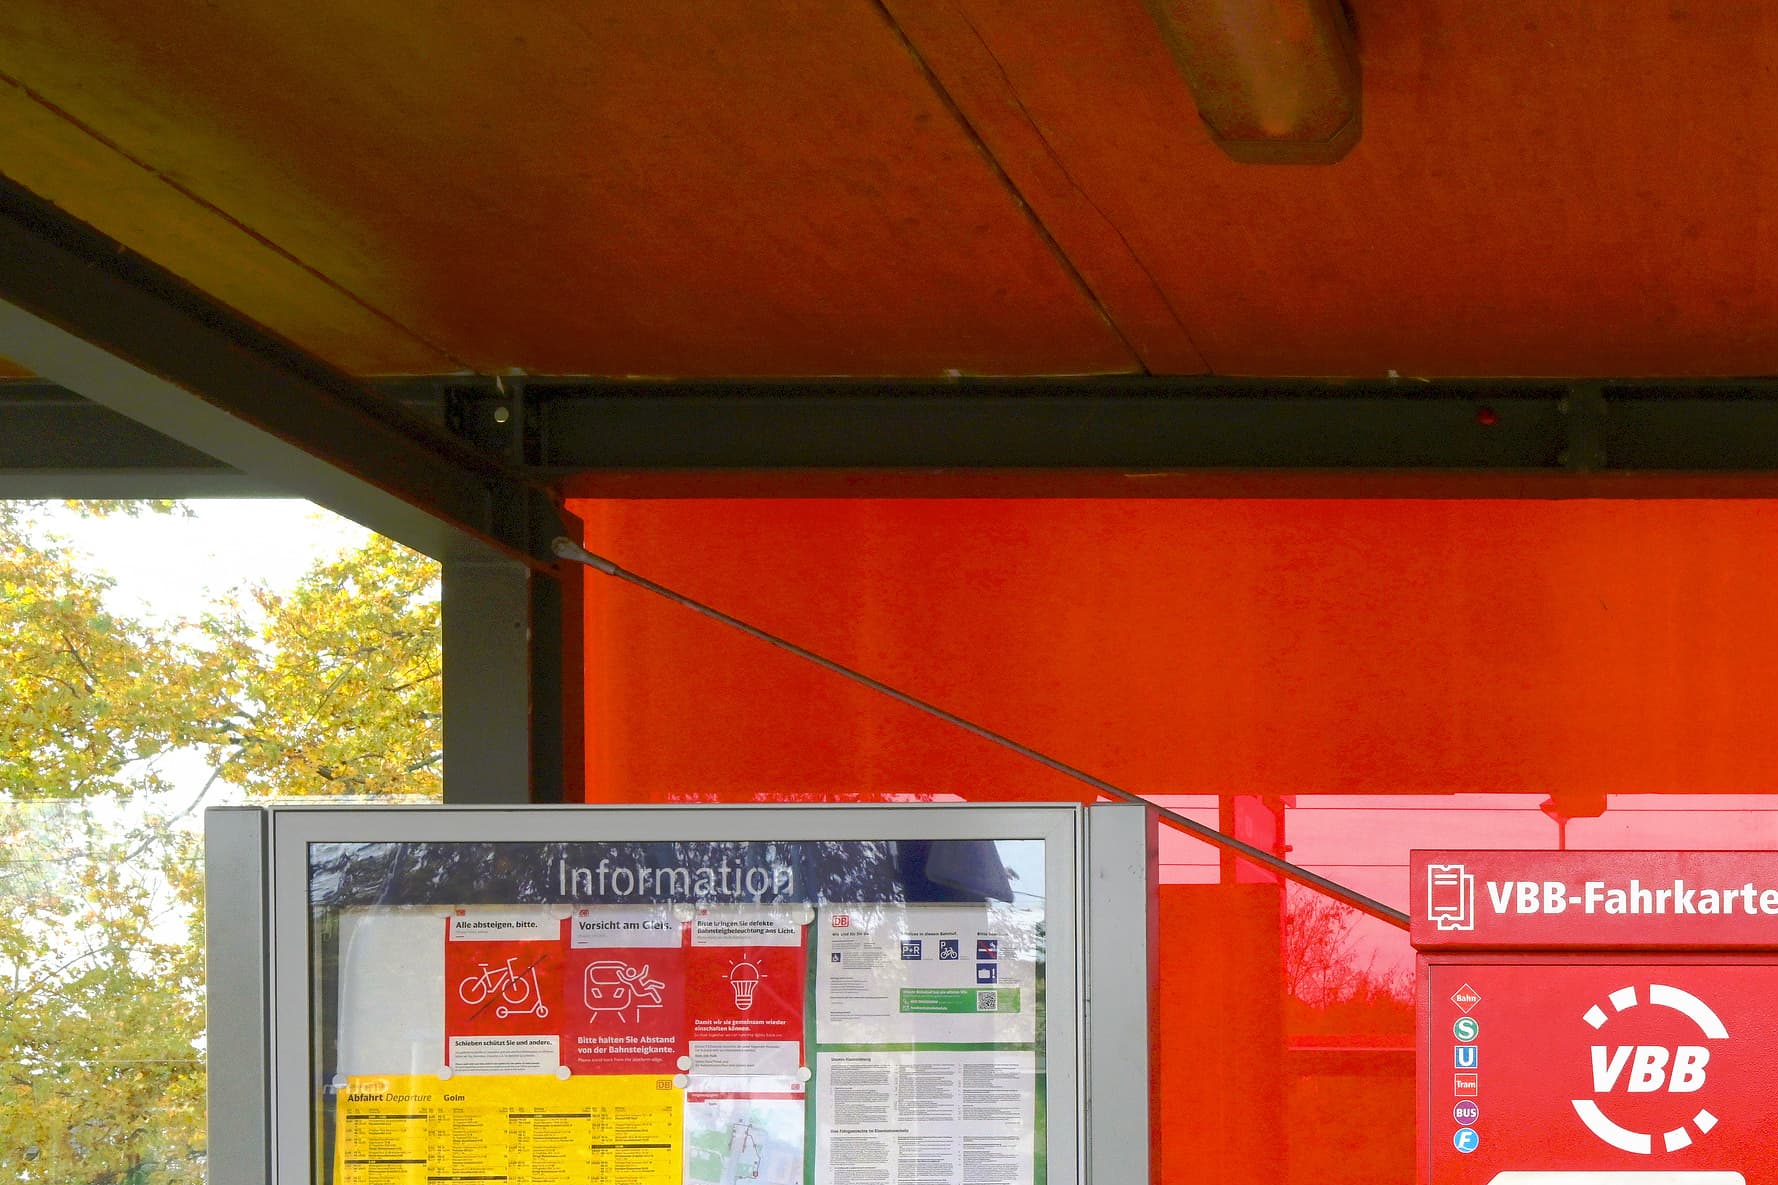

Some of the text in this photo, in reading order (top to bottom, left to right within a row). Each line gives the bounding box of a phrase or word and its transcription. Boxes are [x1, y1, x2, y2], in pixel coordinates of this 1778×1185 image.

[559, 857, 795, 896] Information
[456, 921, 538, 930] Alle absteigen, bitte.
[579, 920, 672, 931] Vorsicht am Gleis.
[941, 941, 946, 949] P
[903, 946, 920, 955] P+R
[1456, 994, 1476, 1002] Bahn
[1458, 1020, 1475, 1039] S
[598, 1036, 624, 1044] halten
[640, 1036, 675, 1044] Abstand
[608, 1046, 676, 1055] Bahnsteigkante.
[1458, 1048, 1474, 1067] U
[1591, 1045, 1710, 1093] VBB
[1456, 1080, 1475, 1088] Tram
[386, 1093, 432, 1103] Departure
[1456, 1108, 1477, 1118] BUS
